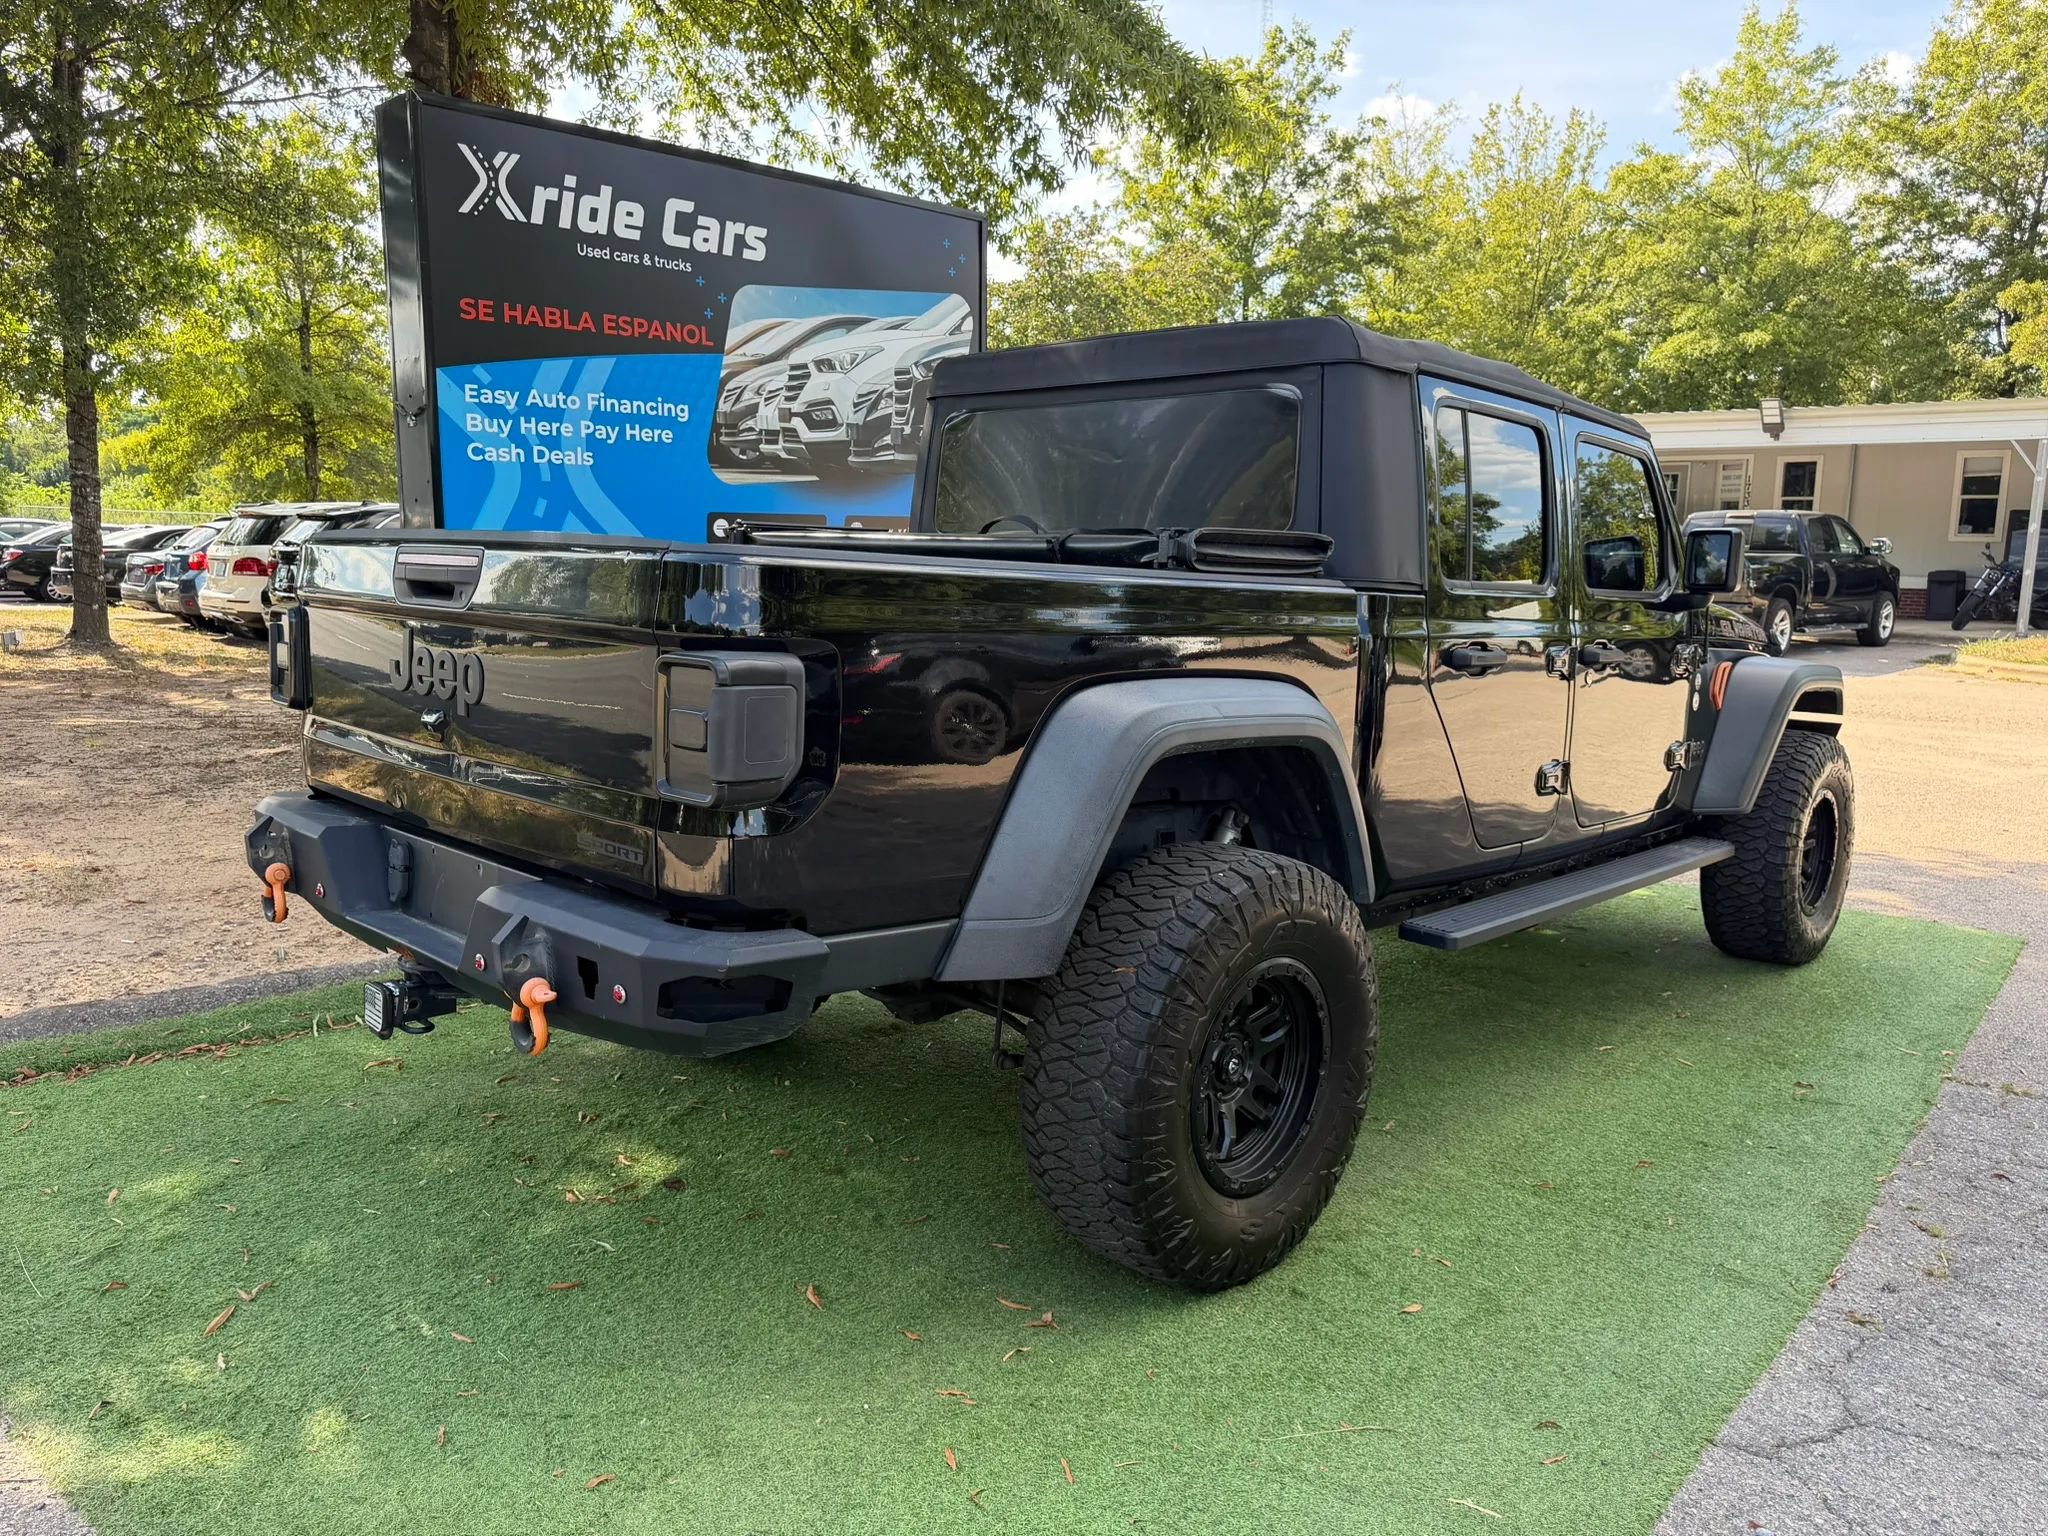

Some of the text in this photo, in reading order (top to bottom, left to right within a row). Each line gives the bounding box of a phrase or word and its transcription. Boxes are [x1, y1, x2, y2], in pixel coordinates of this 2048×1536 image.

[662, 198, 767, 261] Cars
[577, 243, 692, 272] Used cars & trucks
[459, 297, 714, 346] SE HABLA ESPANOL
[464, 384, 689, 422] Easy Auto Financing
[466, 413, 673, 444] Buy Here Pay Here
[467, 442, 594, 466] Cash Deals
[389, 626, 485, 718] Jeep
[577, 833, 644, 864] SPORT
